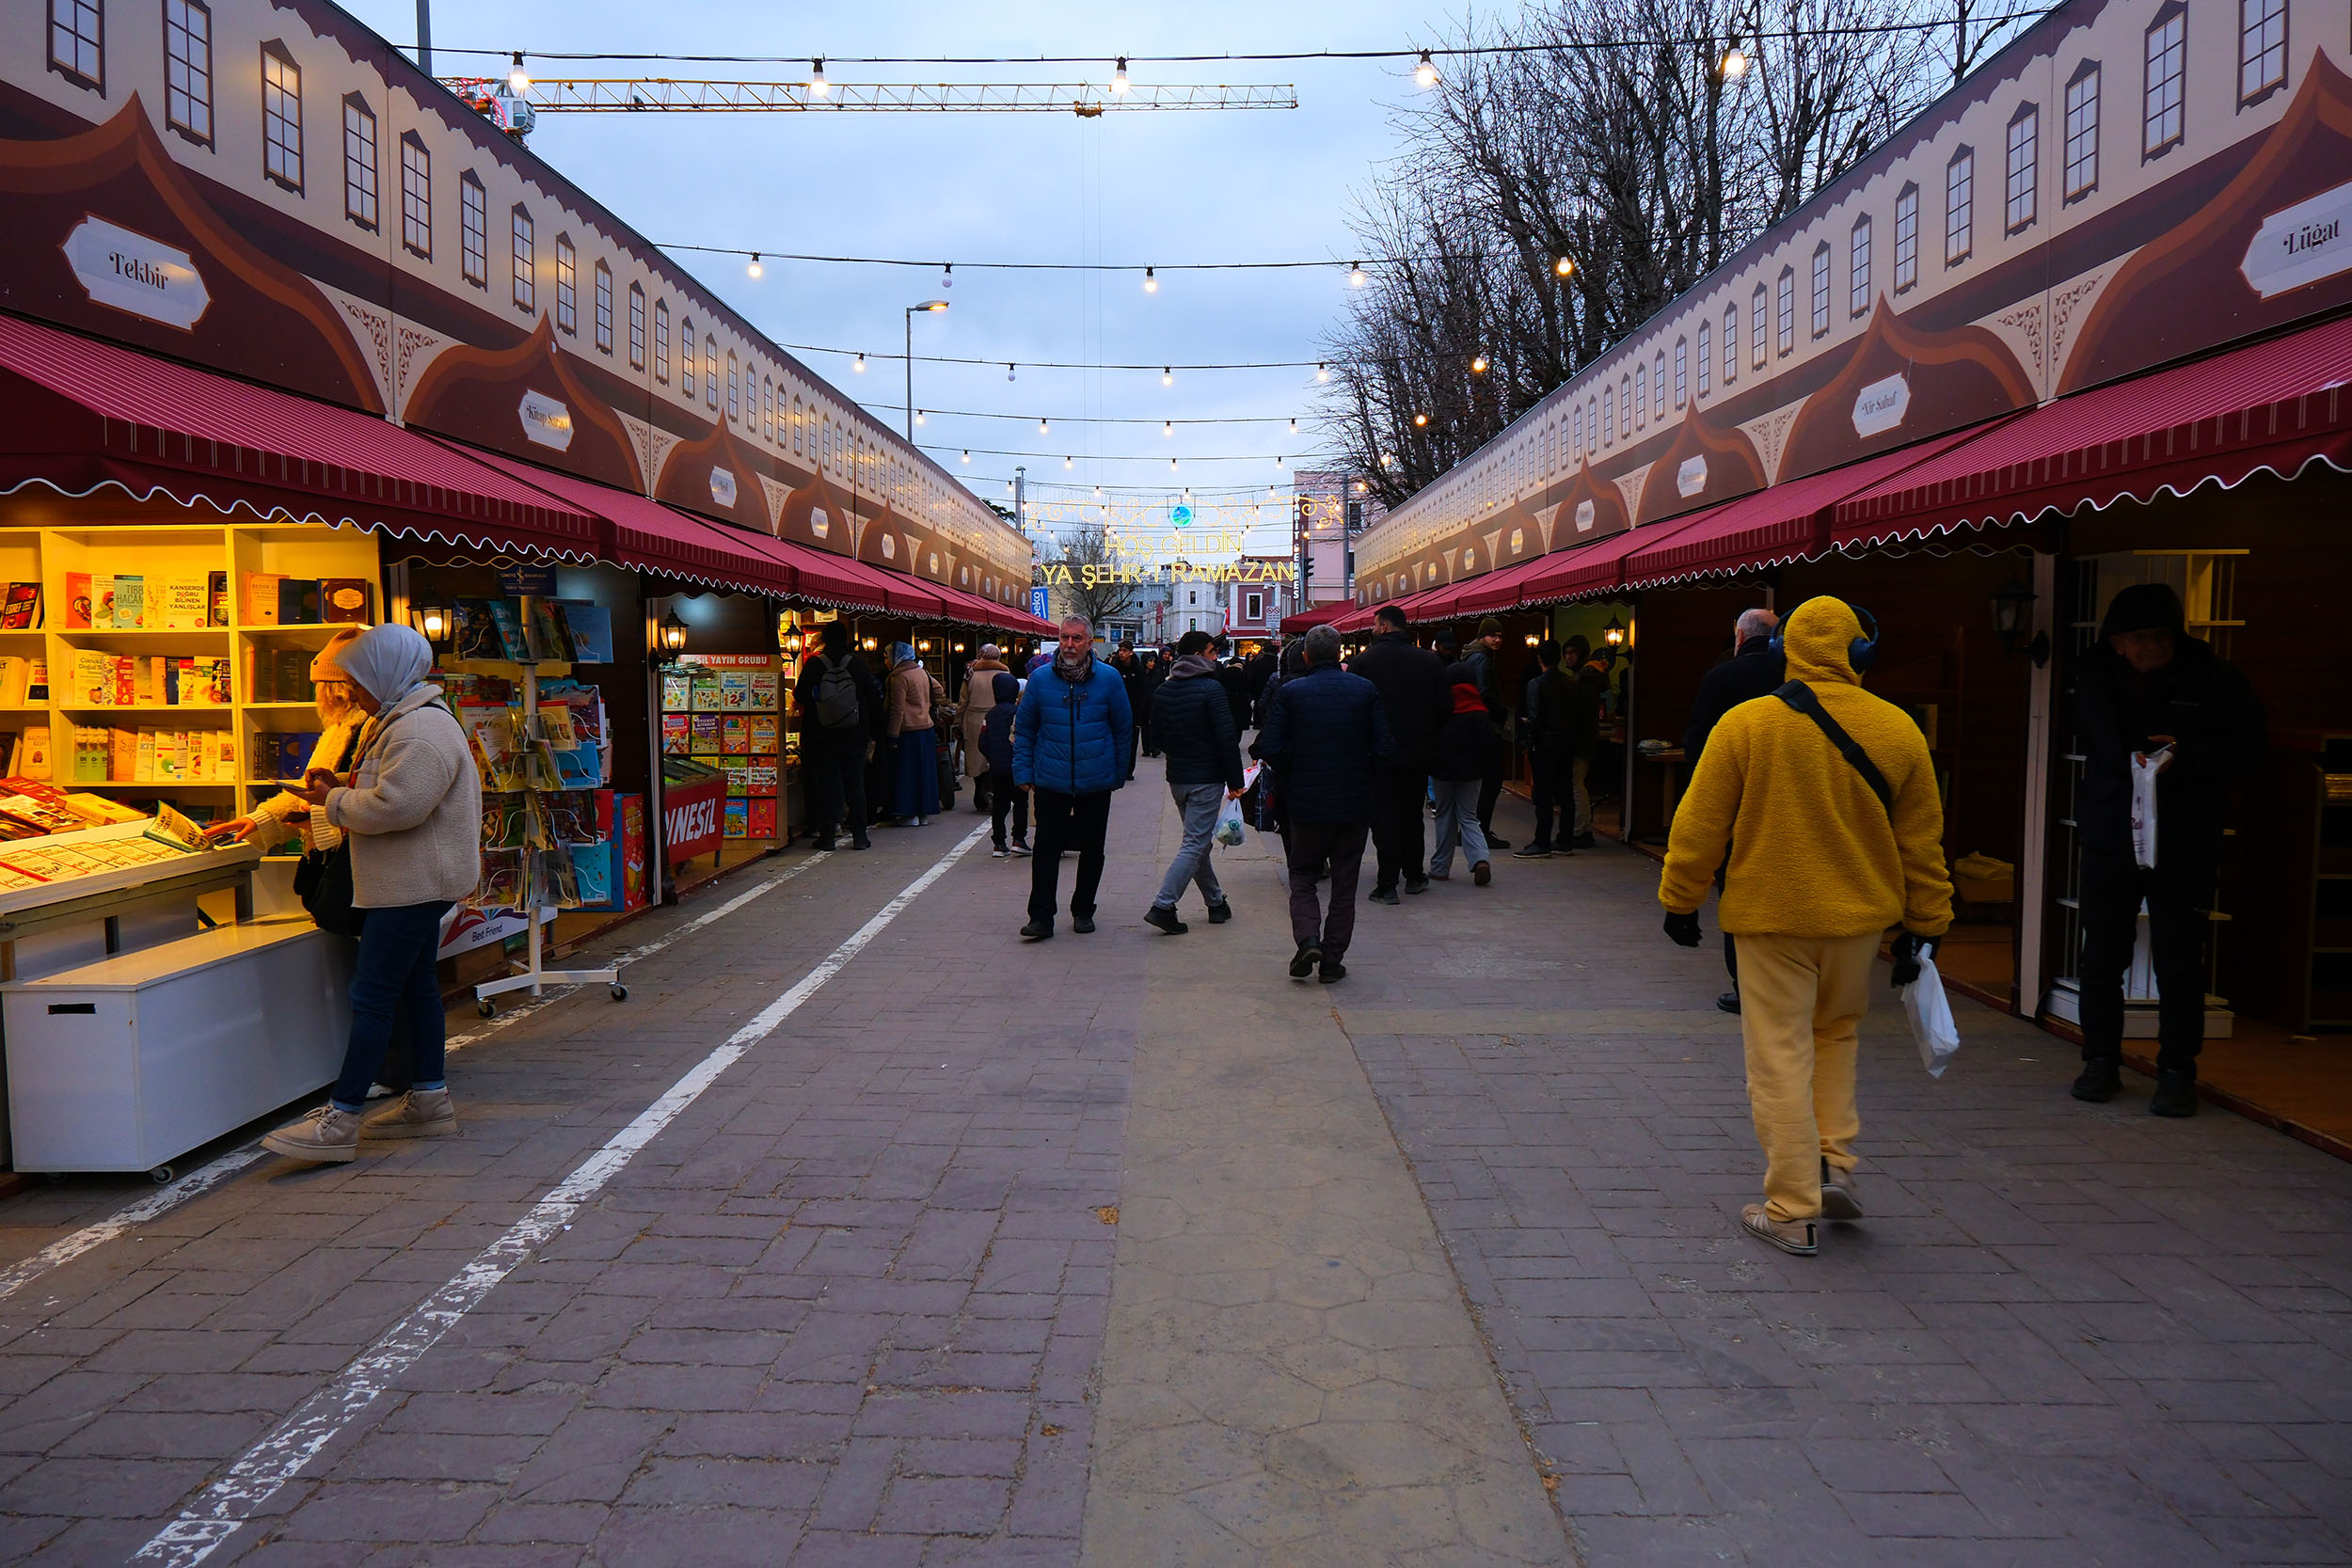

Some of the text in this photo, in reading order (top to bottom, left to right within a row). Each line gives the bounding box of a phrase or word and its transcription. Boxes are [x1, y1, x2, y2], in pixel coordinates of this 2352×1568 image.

[2283, 219, 2339, 255] Lügat
[109, 251, 168, 290] Tekbir
[1104, 529, 1242, 560] HOŞ GELDİN
[1041, 564, 1073, 584] YA
[1171, 562, 1294, 582] RAMAZAN
[711, 656, 736, 664] YAYIN
[738, 656, 768, 664] GRUBU
[472, 922, 503, 942] Best Friend
